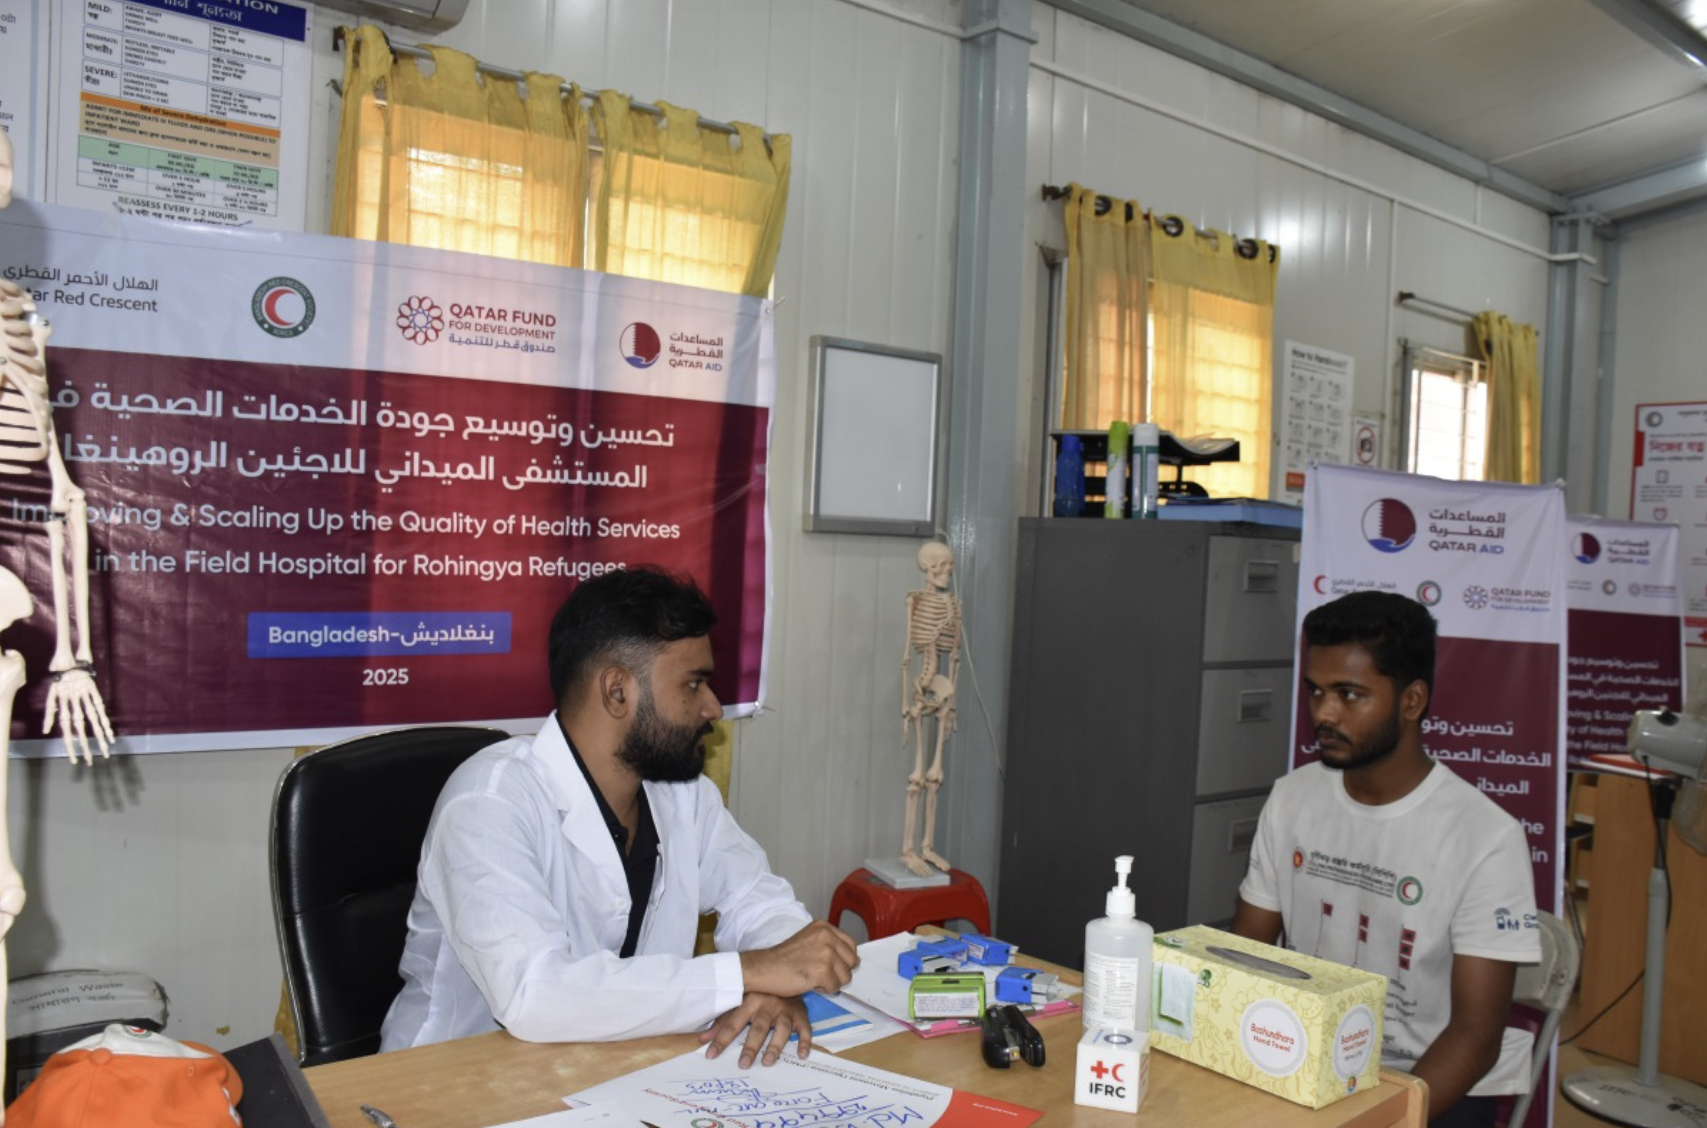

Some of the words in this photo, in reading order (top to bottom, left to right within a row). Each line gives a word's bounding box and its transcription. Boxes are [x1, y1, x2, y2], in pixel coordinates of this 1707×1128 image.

[85, 65, 118, 79] SEVERE:
[118, 195, 162, 210] REASSESS
[163, 202, 191, 214] EVERY
[208, 210, 239, 222] HOURS
[64, 270, 108, 286] الأحمر
[113, 276, 158, 291] الهلال
[54, 289, 85, 306] Red
[89, 293, 158, 312] Crescent
[450, 302, 507, 322] QATAR
[512, 310, 556, 328] FUND
[449, 320, 472, 330] FOR
[474, 323, 556, 340] DEVELOPMENT
[669, 359, 703, 369] QATAR
[705, 363, 722, 371] AID
[49, 380, 80, 408] ف
[91, 382, 224, 420] الصحية
[232, 394, 367, 426] الخدمات
[376, 401, 455, 438] جودة
[461, 414, 574, 446] وتوسيع
[580, 422, 674, 449] تحسين
[64, 433, 228, 475] الروهينغا
[237, 446, 366, 479] للاجئين
[374, 451, 495, 493] الميداني
[502, 455, 647, 490] المستشفى
[12, 498, 162, 531] Imoving
[170, 503, 190, 526] &
[199, 503, 299, 534] Scaling
[307, 507, 344, 535] Up
[350, 509, 393, 532] the
[399, 510, 488, 538] Quality
[493, 514, 516, 535] of
[521, 515, 591, 537] Health
[597, 517, 681, 539] Services
[1428, 540, 1477, 554] QATAR
[1480, 542, 1504, 555] AID
[95, 548, 119, 571] in
[130, 549, 176, 571] the
[185, 550, 250, 573] Field
[258, 552, 366, 580] Hospital
[373, 553, 407, 575] for
[413, 554, 522, 581] Rohingya
[362, 667, 409, 686] 2025
[1449, 721, 1514, 736] تحسين
[1482, 750, 1551, 767] الخدمات
[1520, 818, 1544, 835] he
[1531, 846, 1548, 863] in
[1250, 1022, 1295, 1045] Bashundhara
[1253, 1035, 1271, 1047] Hand
[1272, 1040, 1291, 1053] Towel
[1089, 1082, 1126, 1099] IFRC
